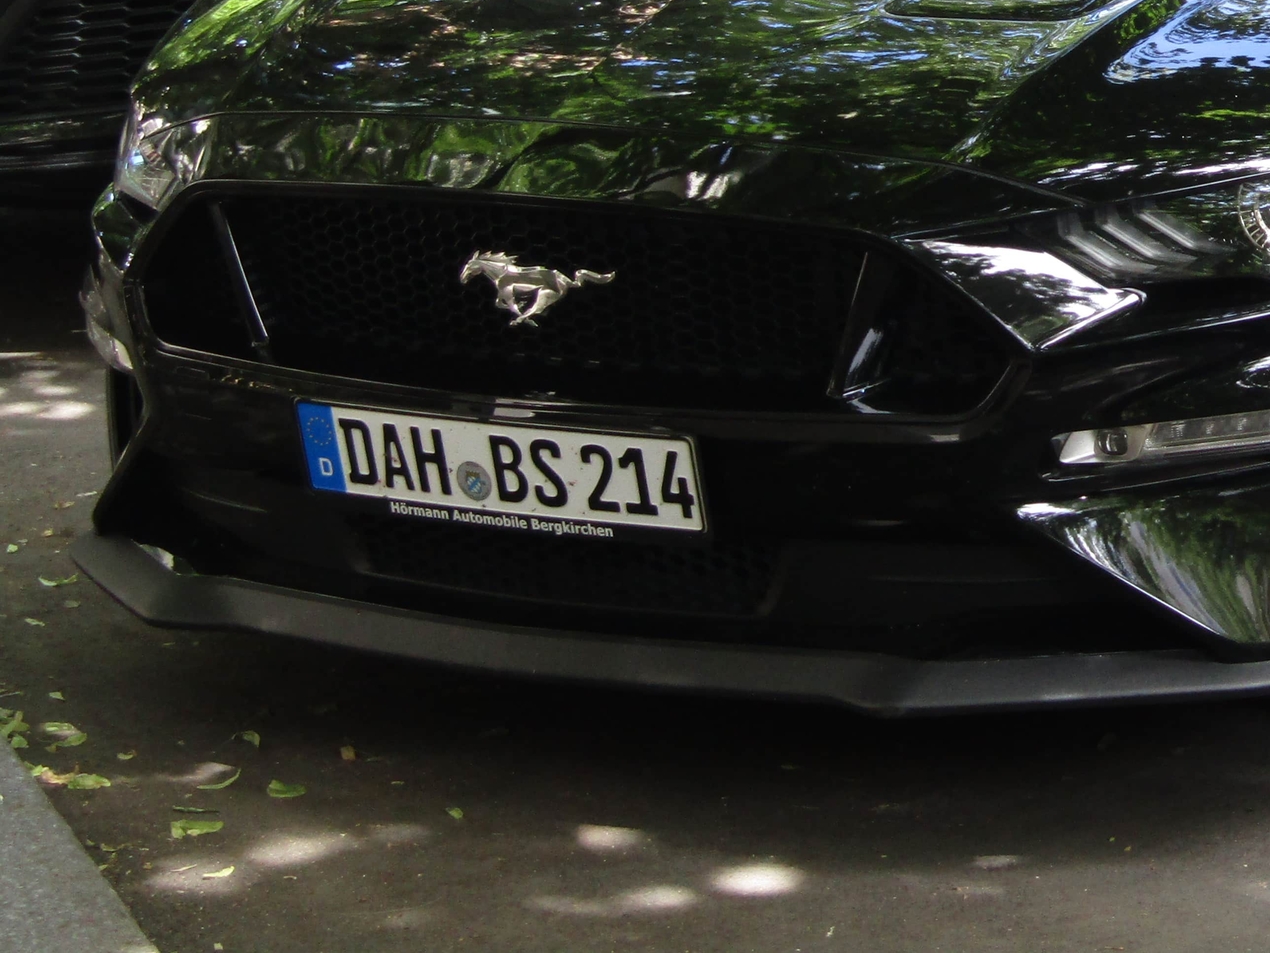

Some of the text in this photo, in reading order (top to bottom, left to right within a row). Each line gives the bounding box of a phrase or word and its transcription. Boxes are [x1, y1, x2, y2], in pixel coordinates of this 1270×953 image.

[318, 456, 334, 477] D
[338, 417, 695, 519] DAH BS 214
[390, 501, 614, 537] Hörmann Automobile Bergkirchen
